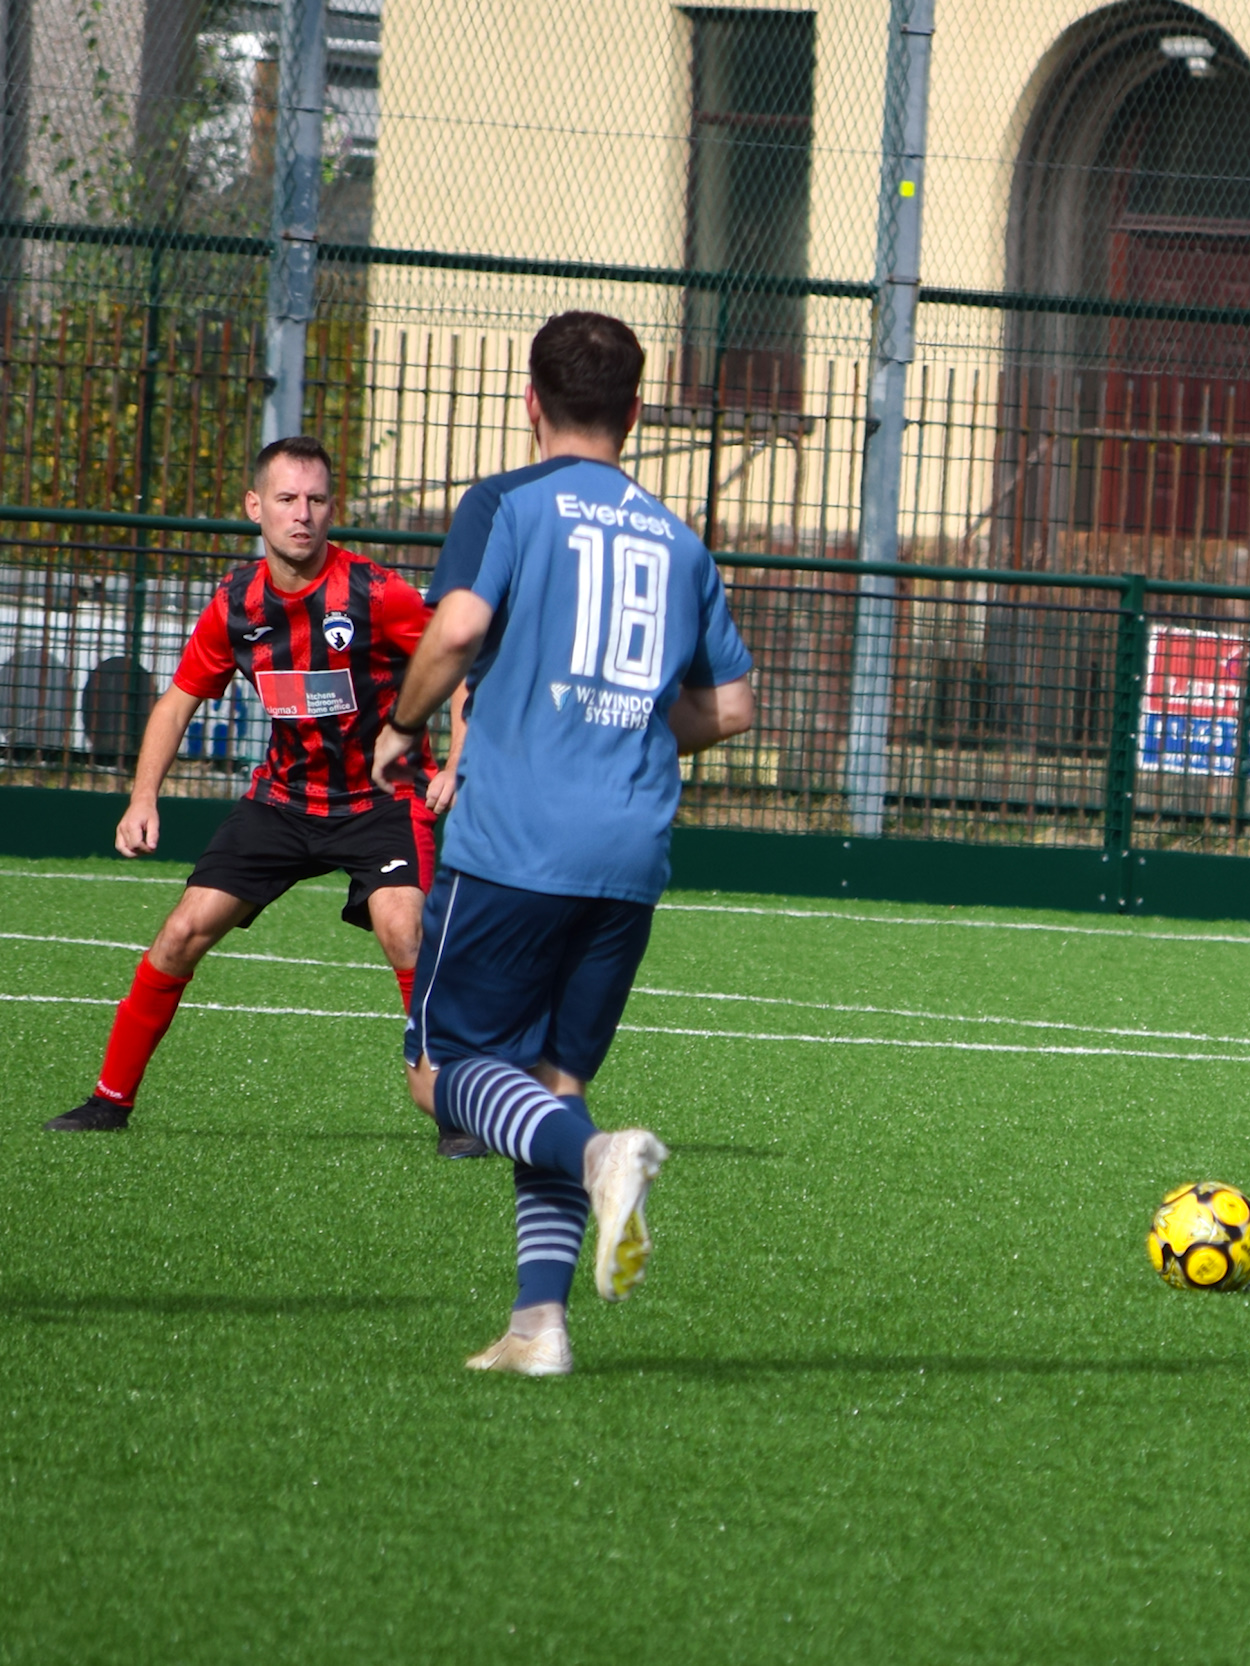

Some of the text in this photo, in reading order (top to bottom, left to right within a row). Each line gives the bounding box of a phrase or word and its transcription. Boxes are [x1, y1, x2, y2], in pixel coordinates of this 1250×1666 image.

[556, 493, 675, 540] Everest
[568, 524, 670, 691] 18
[576, 685, 654, 714] W2 WINDO
[585, 706, 650, 730] SYSTEMS
